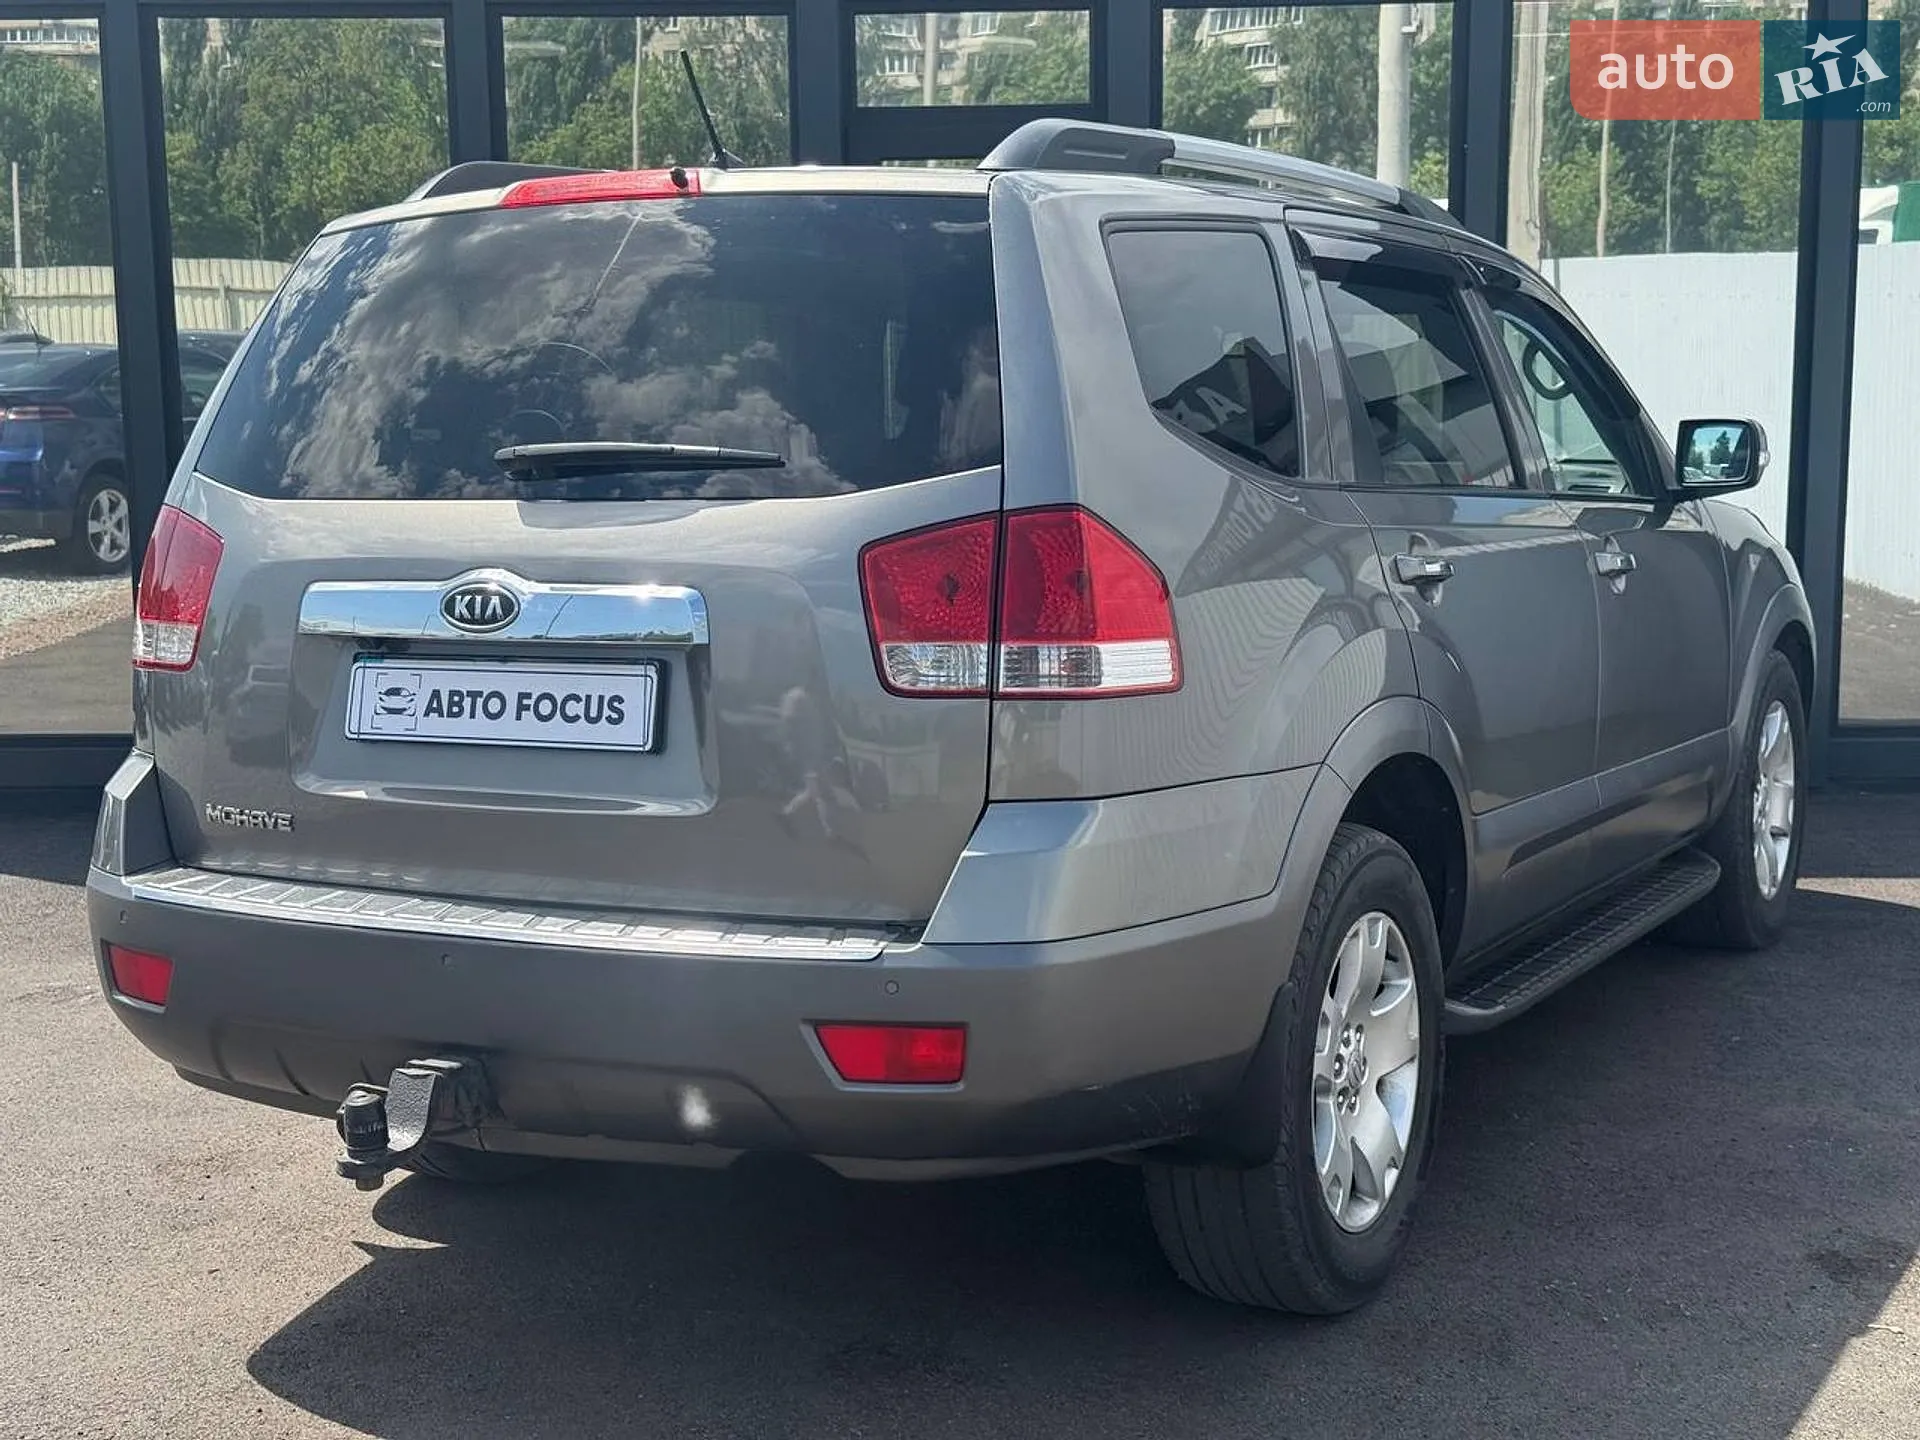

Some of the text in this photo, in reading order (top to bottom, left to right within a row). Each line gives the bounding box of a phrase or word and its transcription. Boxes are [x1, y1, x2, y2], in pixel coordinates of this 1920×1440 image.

[454, 594, 505, 620] KIA
[515, 692, 626, 726] FOCUS
[205, 803, 295, 832] MOHAVE
